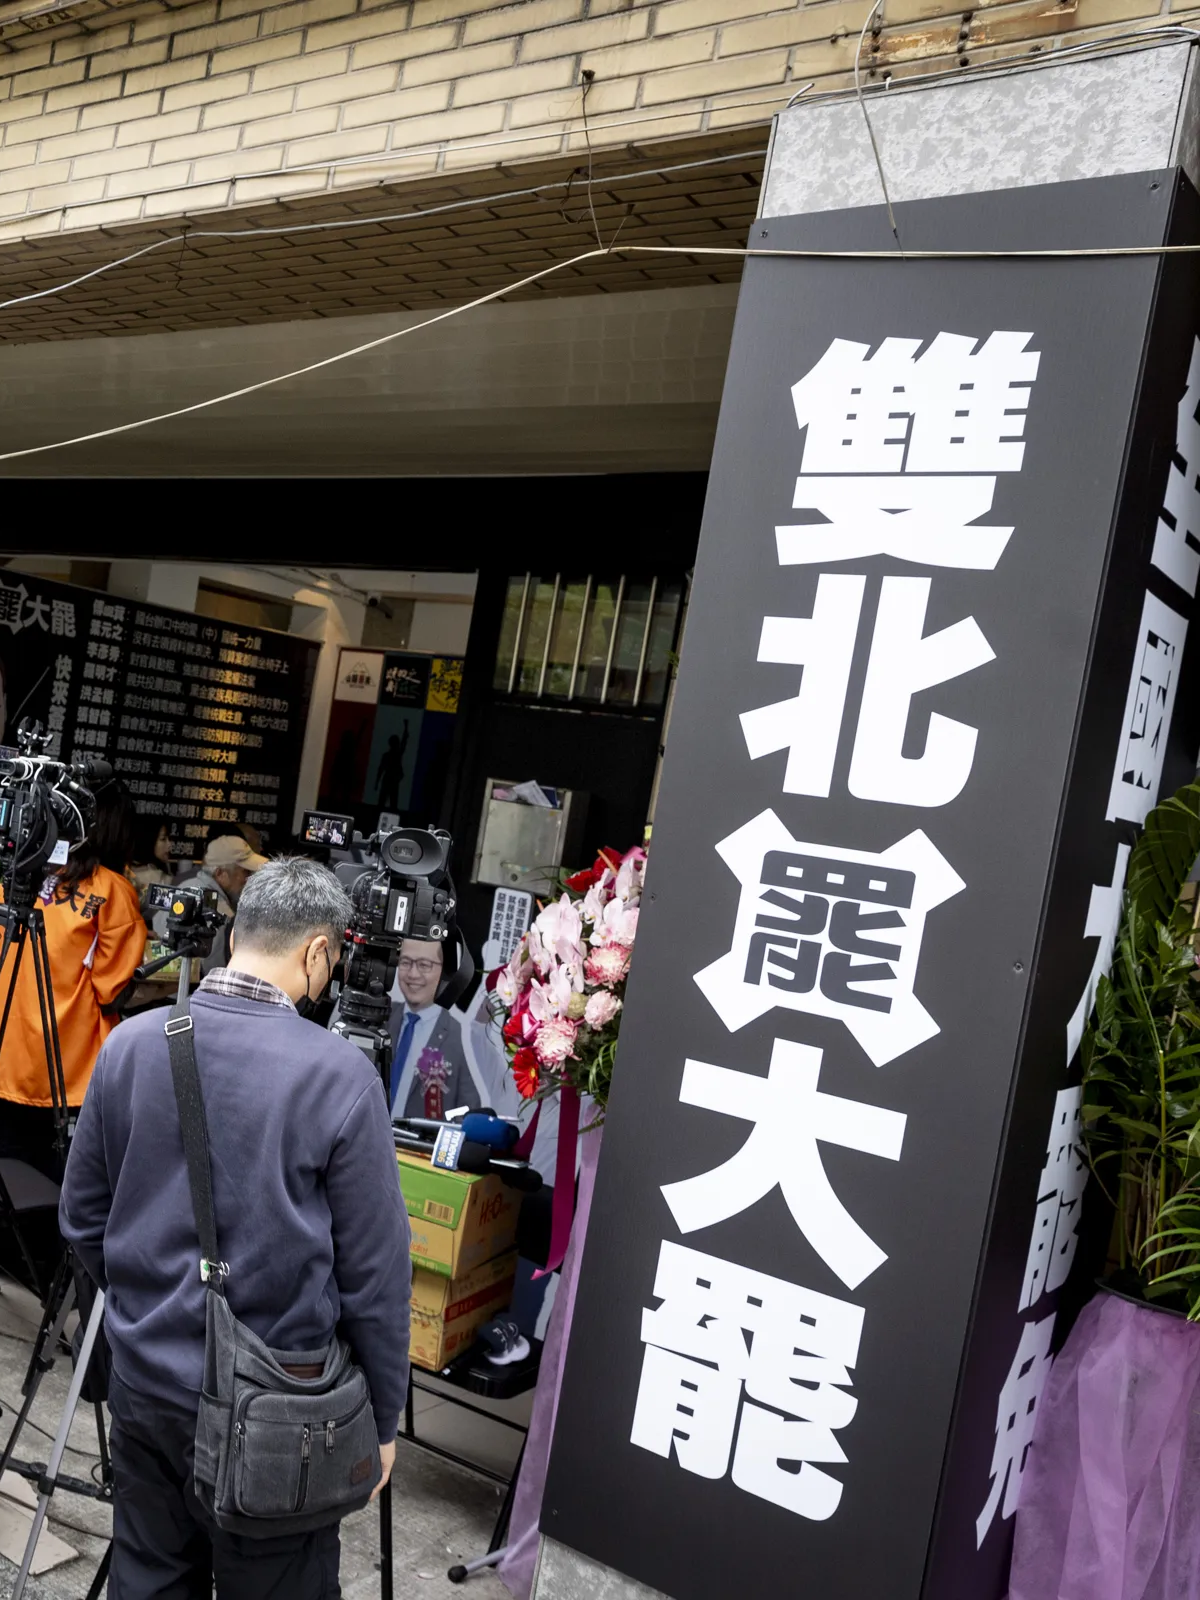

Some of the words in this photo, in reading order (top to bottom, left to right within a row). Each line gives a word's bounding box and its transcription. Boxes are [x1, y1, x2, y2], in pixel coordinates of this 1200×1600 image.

[630, 331, 1041, 1521] 雙北罷大罷
